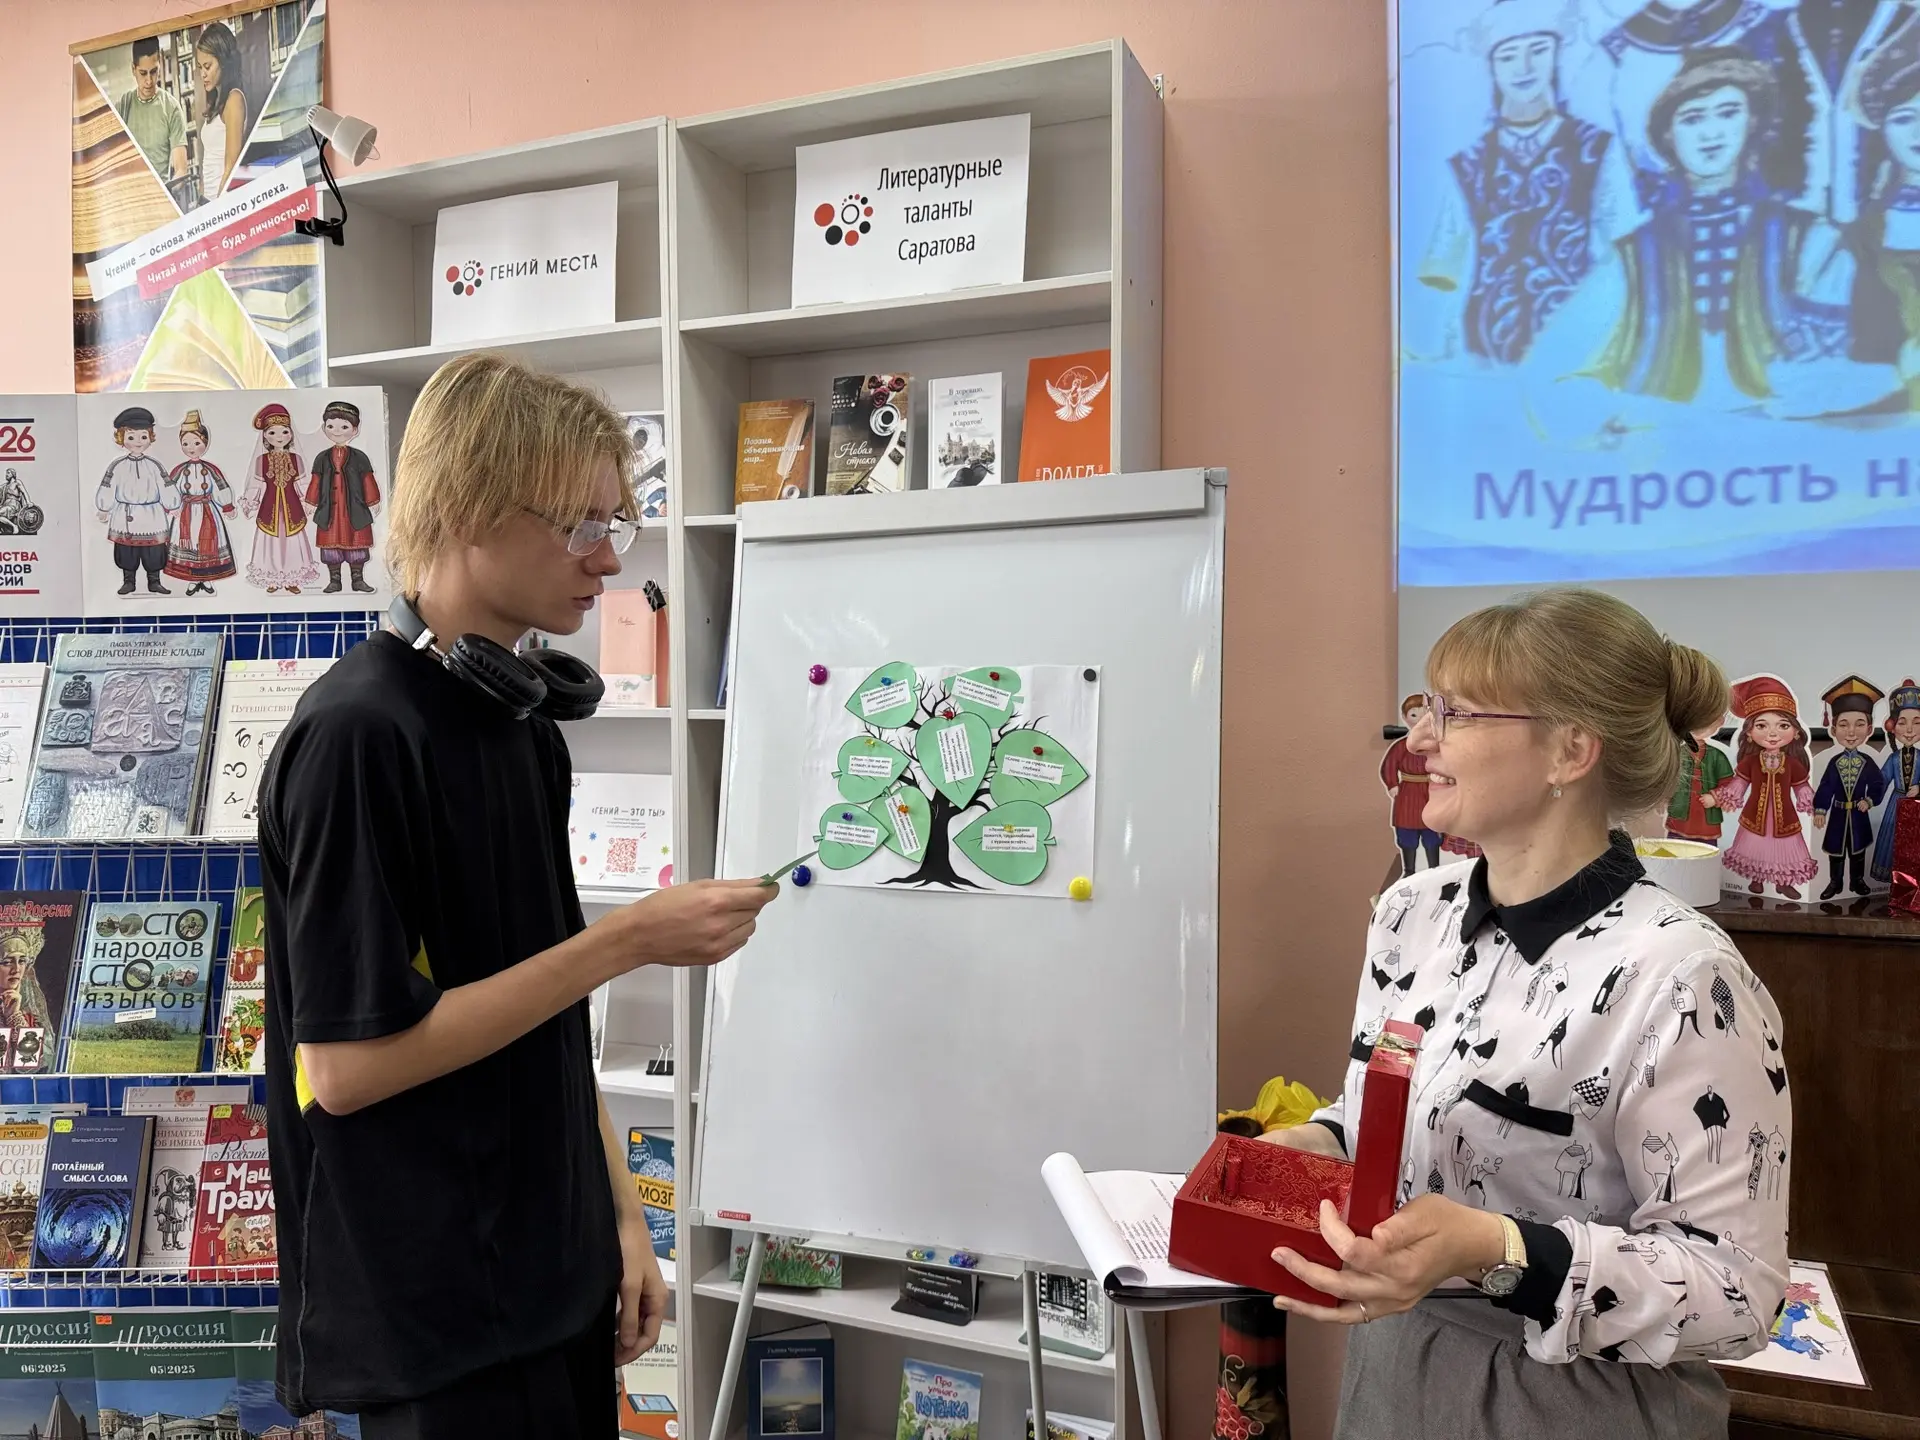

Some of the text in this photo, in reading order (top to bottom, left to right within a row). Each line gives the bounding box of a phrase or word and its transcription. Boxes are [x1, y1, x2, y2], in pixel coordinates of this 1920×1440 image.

[877, 158, 1002, 192] Литературные
[904, 199, 973, 224] таланты
[105, 255, 137, 279] Чтение
[150, 233, 184, 256] основа
[186, 203, 247, 240] жизненного
[250, 181, 289, 209] успеха.
[147, 263, 178, 284] Читай
[179, 250, 209, 271] книги
[222, 231, 247, 249] будь
[249, 198, 310, 238] личностью!
[898, 233, 975, 265] Саратова
[490, 253, 598, 281] ГЕНИЙ МЕСТА
[0, 425, 36, 453] 26
[834, 440, 873, 459] Новая
[846, 456, 877, 469] строка
[1473, 456, 1920, 531] Мудрость н
[0, 551, 39, 563] СТВА
[66, 648, 206, 658] СЛОВ ДРАГОЦЕННЫЕ КЛАДЫ
[591, 806, 619, 815] «ГЕНИЙ
[630, 808, 645, 816] ЭТО
[143, 908, 209, 941] СТО
[92, 941, 204, 963] народов
[89, 958, 155, 991] СТО
[83, 992, 195, 1009] языков
[155, 1139, 168, 1147] ОБ
[51, 1161, 105, 1171] ПОТАЁННЫЙ
[630, 1152, 651, 1162] ОДНО
[63, 1174, 128, 1183] СМЫСЛ СЛОВА
[638, 1184, 674, 1206] МОЗГ
[16, 1322, 91, 1336] РОССИЯ
[145, 1322, 226, 1337] РОССИЯ
[647, 1343, 677, 1354] РВАТЬС
[935, 1375, 952, 1388] Про
[927, 1385, 958, 1398] умного
[915, 1390, 969, 1420] КОТЁНКА
